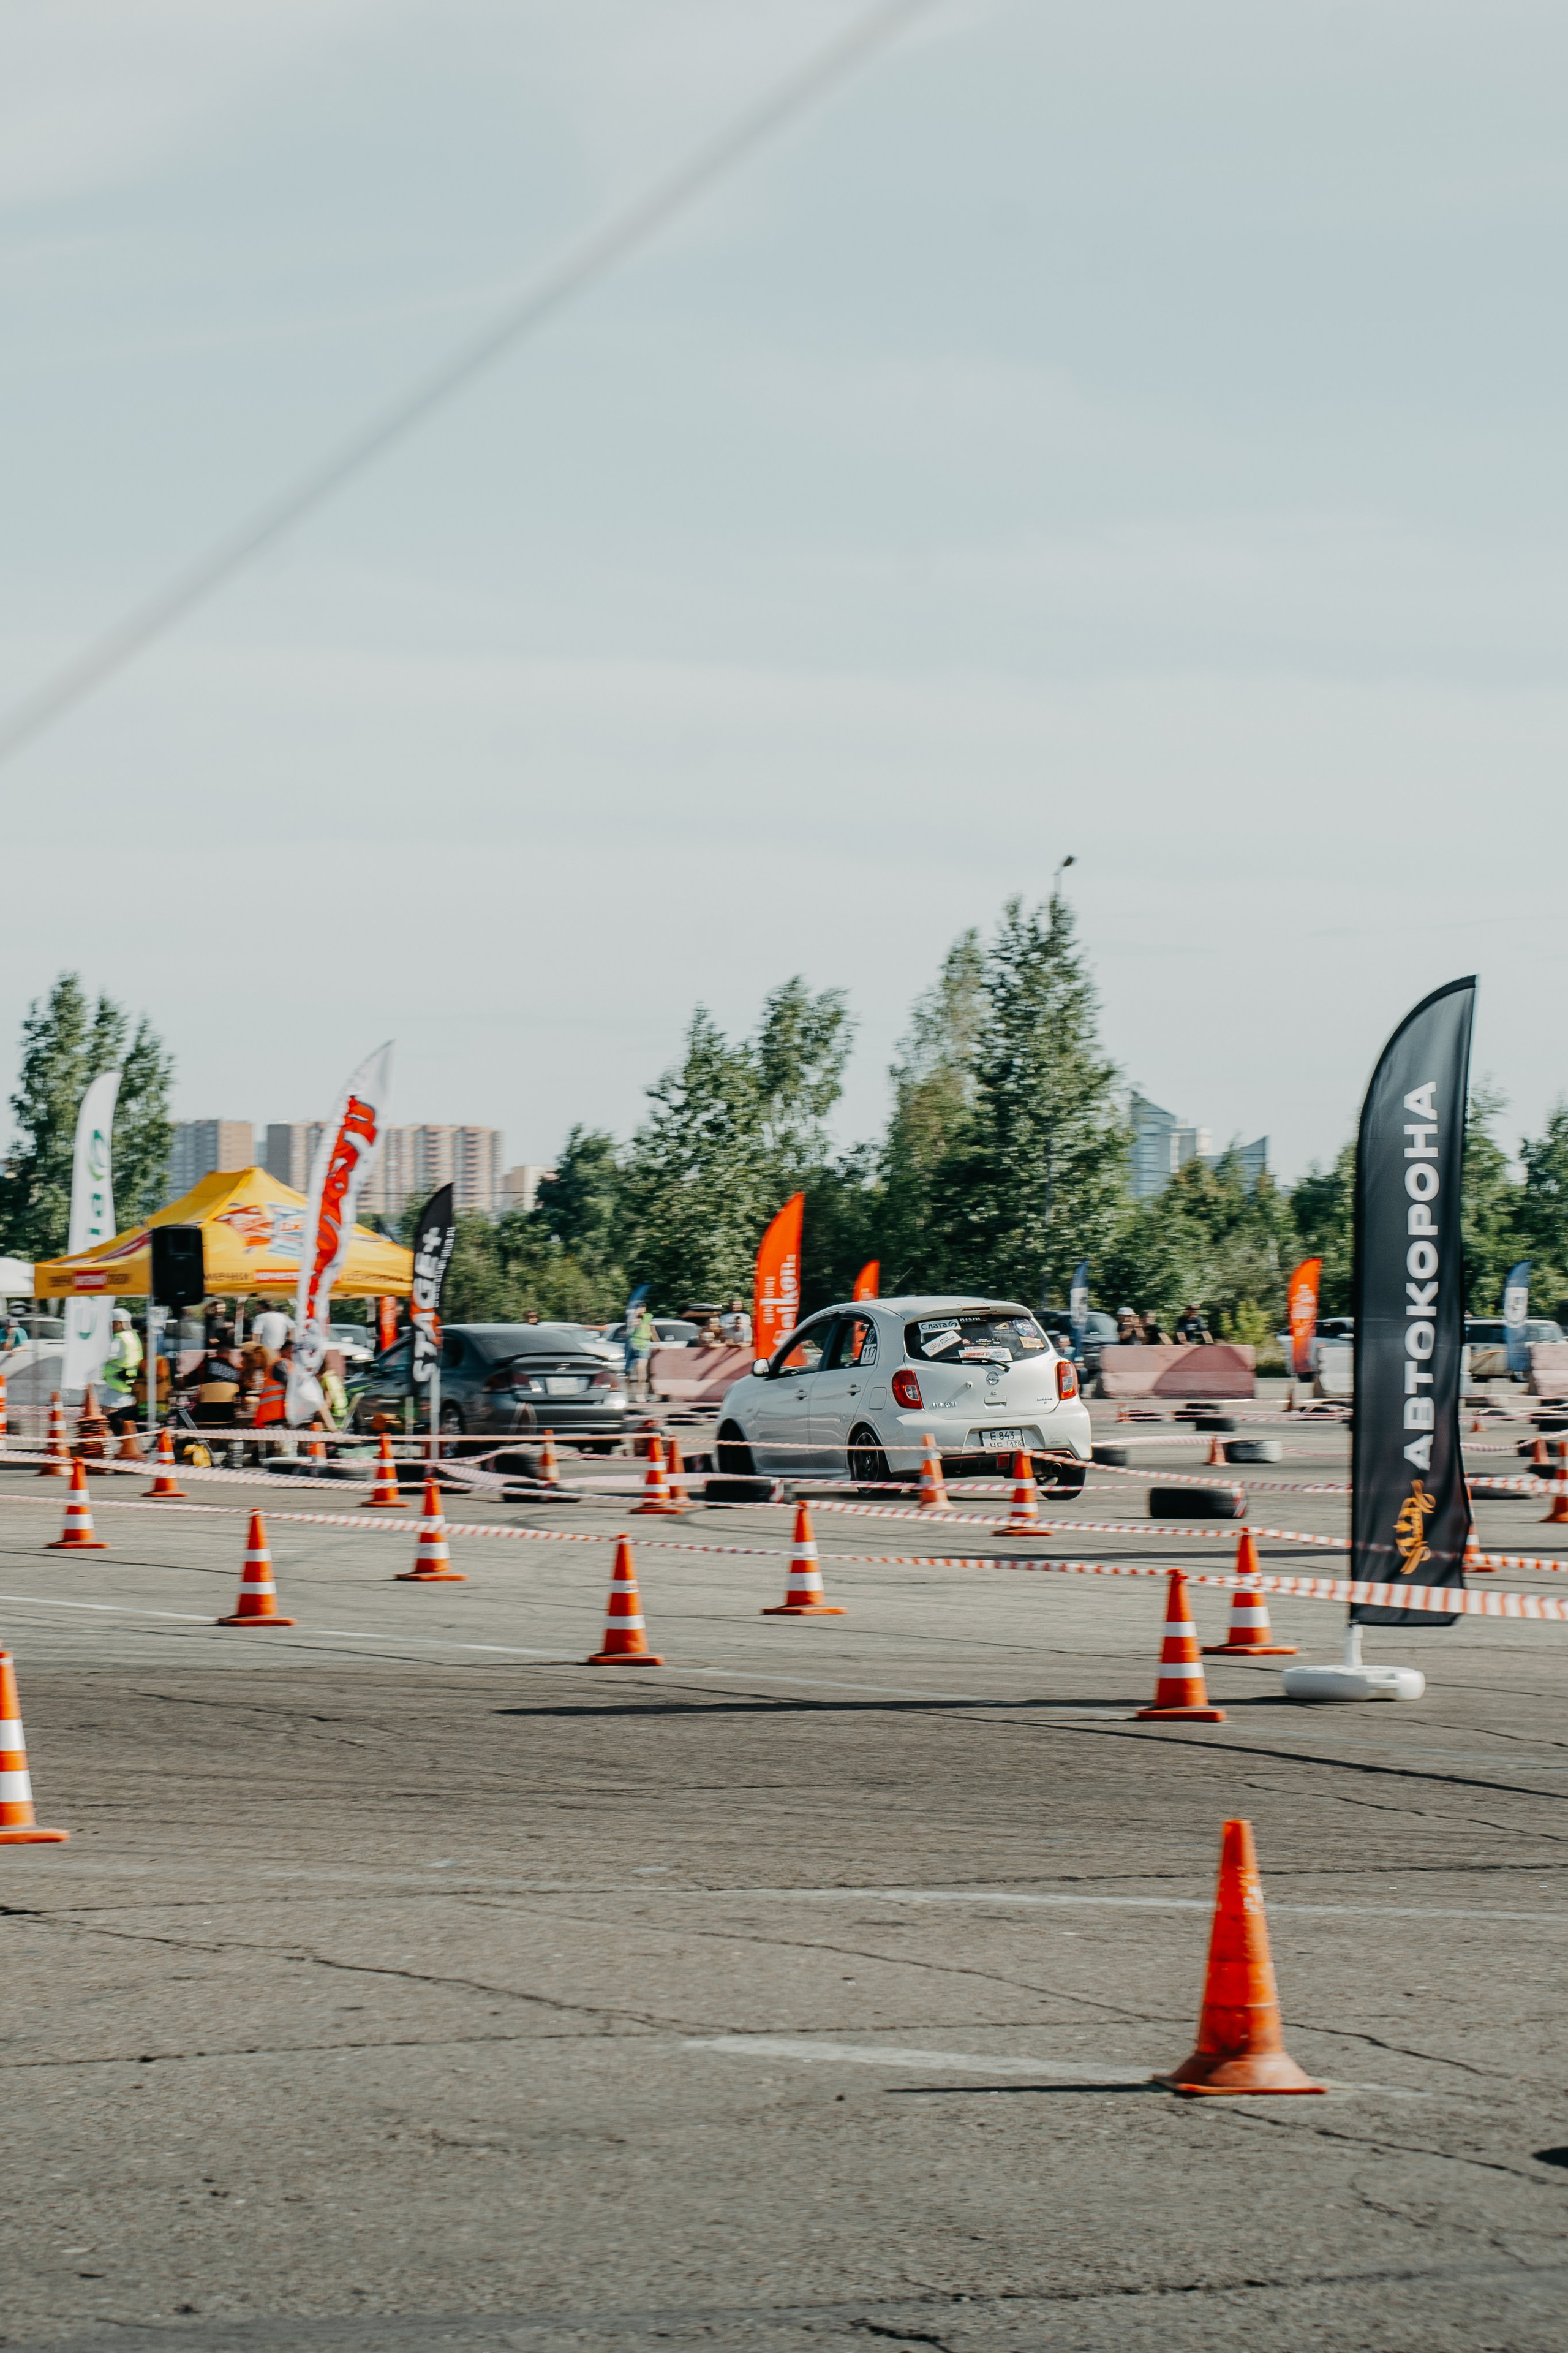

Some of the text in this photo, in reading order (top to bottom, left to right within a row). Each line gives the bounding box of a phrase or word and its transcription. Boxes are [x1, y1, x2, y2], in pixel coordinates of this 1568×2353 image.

[1403, 1081, 1440, 1471] АВТОКОРОНА
[920, 1321, 947, 1331] Слата
[864, 1346, 876, 1358] 117
[998, 1430, 1015, 1440] 843
